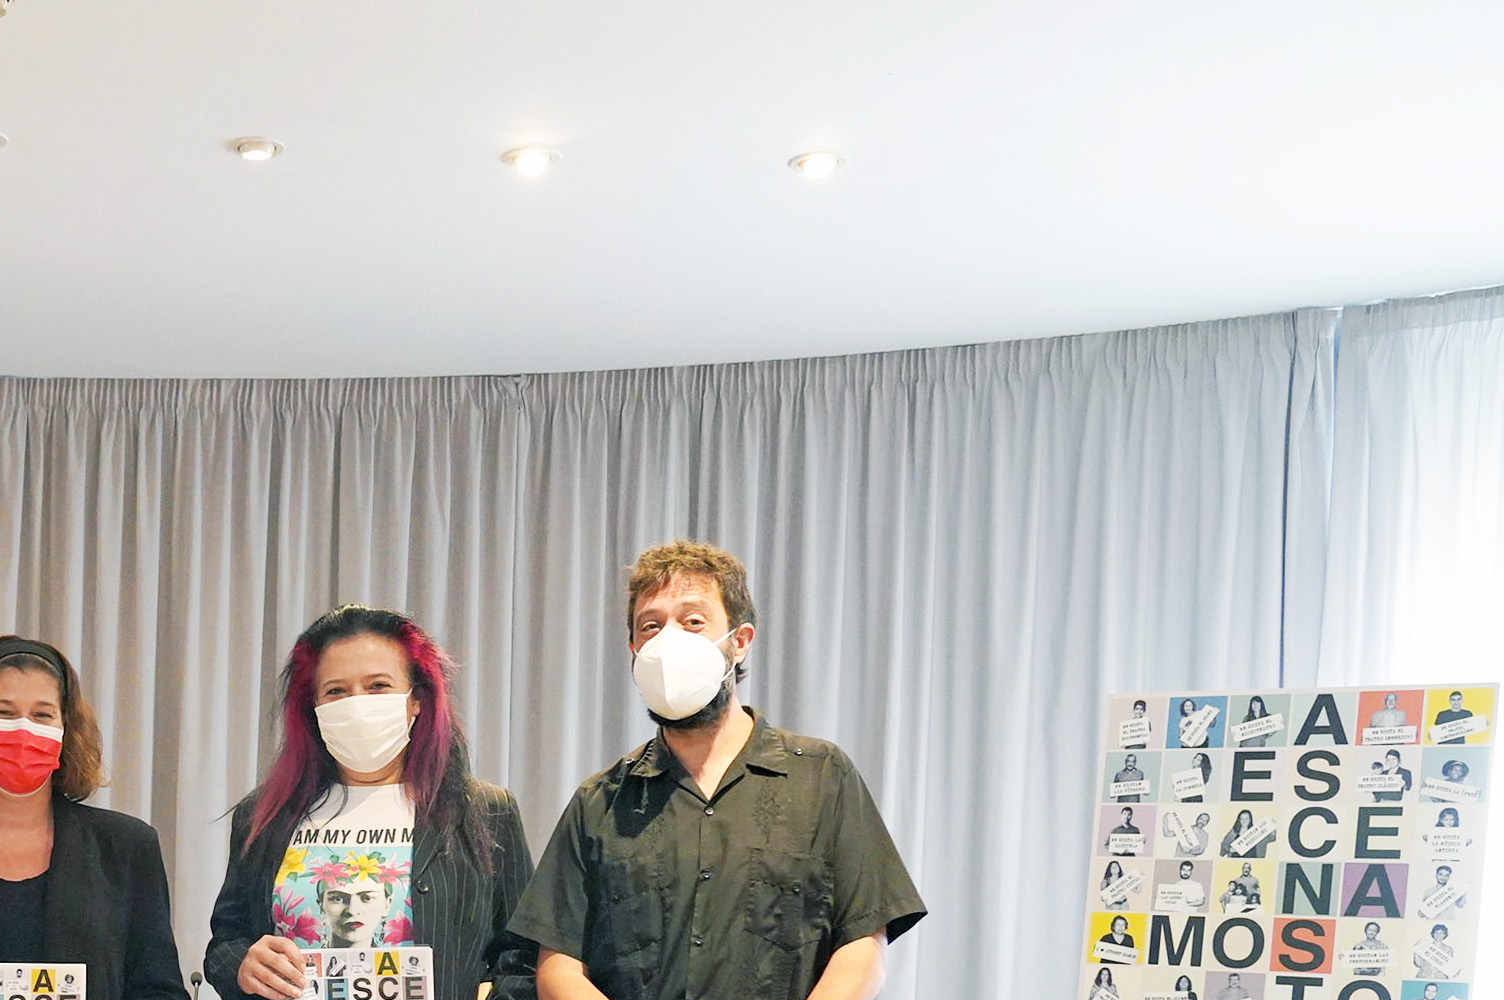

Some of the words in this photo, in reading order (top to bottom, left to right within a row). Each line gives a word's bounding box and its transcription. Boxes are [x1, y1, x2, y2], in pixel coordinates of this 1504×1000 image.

[1293, 693, 1349, 746] A
[293, 830, 320, 846] AM
[323, 829, 351, 844] MY
[356, 828, 396, 844] OWN
[378, 952, 398, 975] A
[33, 969, 54, 992] A
